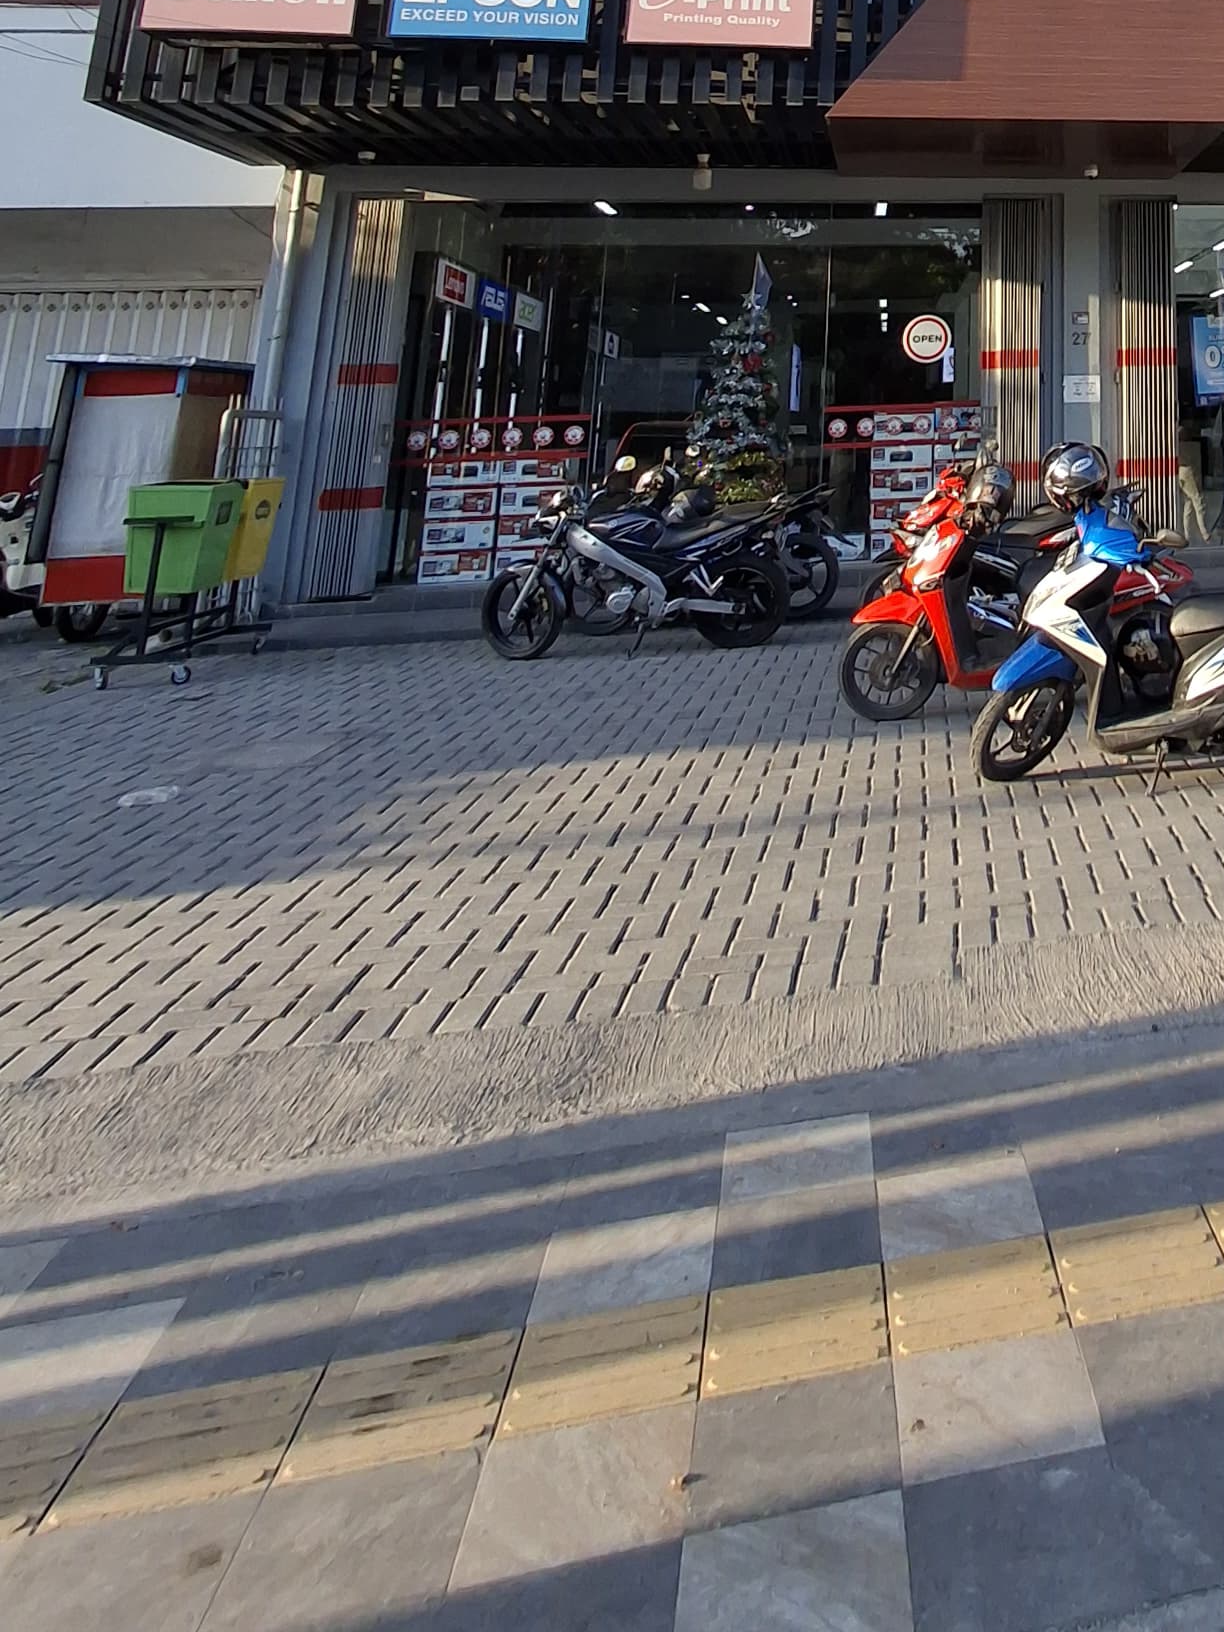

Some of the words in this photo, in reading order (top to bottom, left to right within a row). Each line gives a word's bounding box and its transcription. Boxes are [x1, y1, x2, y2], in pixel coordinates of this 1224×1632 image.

[400, 8, 467, 23] EXCEED
[472, 10, 520, 25] YOUR
[523, 12, 580, 27] VISION
[663, 12, 723, 26] Printing
[727, 14, 781, 28] Quality
[912, 334, 943, 343] OPEN
[1071, 331, 1092, 346] 27
